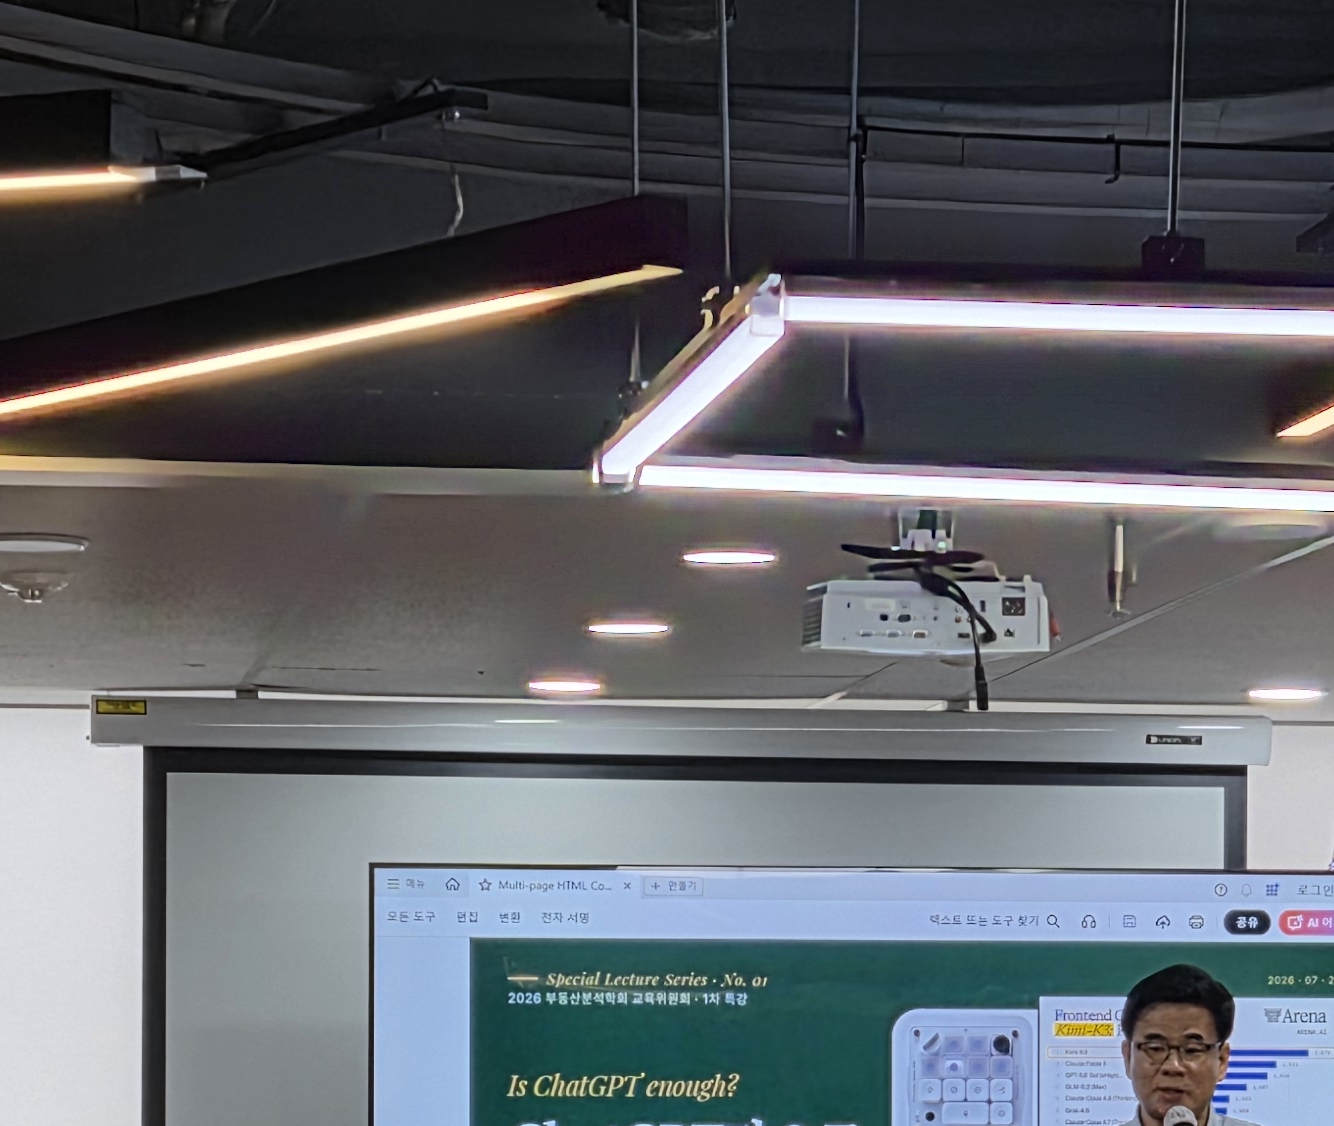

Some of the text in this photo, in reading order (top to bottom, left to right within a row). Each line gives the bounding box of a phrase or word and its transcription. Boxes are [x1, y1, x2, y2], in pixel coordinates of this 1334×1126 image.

[498, 880, 554, 892] Multi-page
[557, 880, 588, 891] HTML
[1297, 884, 1334, 897] 로그인
[387, 911, 436, 923] 모든 도구
[457, 911, 479, 924] 편집
[499, 911, 521, 924] 변환
[541, 911, 590, 924] 전자 서명
[929, 914, 1040, 927] 텍스트 또는 도구 찾기
[1235, 917, 1259, 929] 공유
[1307, 918, 1319, 928] AI
[546, 971, 600, 987] Special
[605, 972, 659, 986] Lecture
[664, 972, 708, 987] Series
[721, 972, 747, 988] No.
[1267, 976, 1295, 985] 2026
[1305, 976, 1318, 985] 07
[508, 991, 748, 1006] 2026 부동산분석학회 교육위원회 1차 특강
[1055, 1009, 1112, 1021] Frontend
[1282, 1008, 1327, 1024] Arena
[507, 1072, 740, 1102] Is ChatGPT enough?
